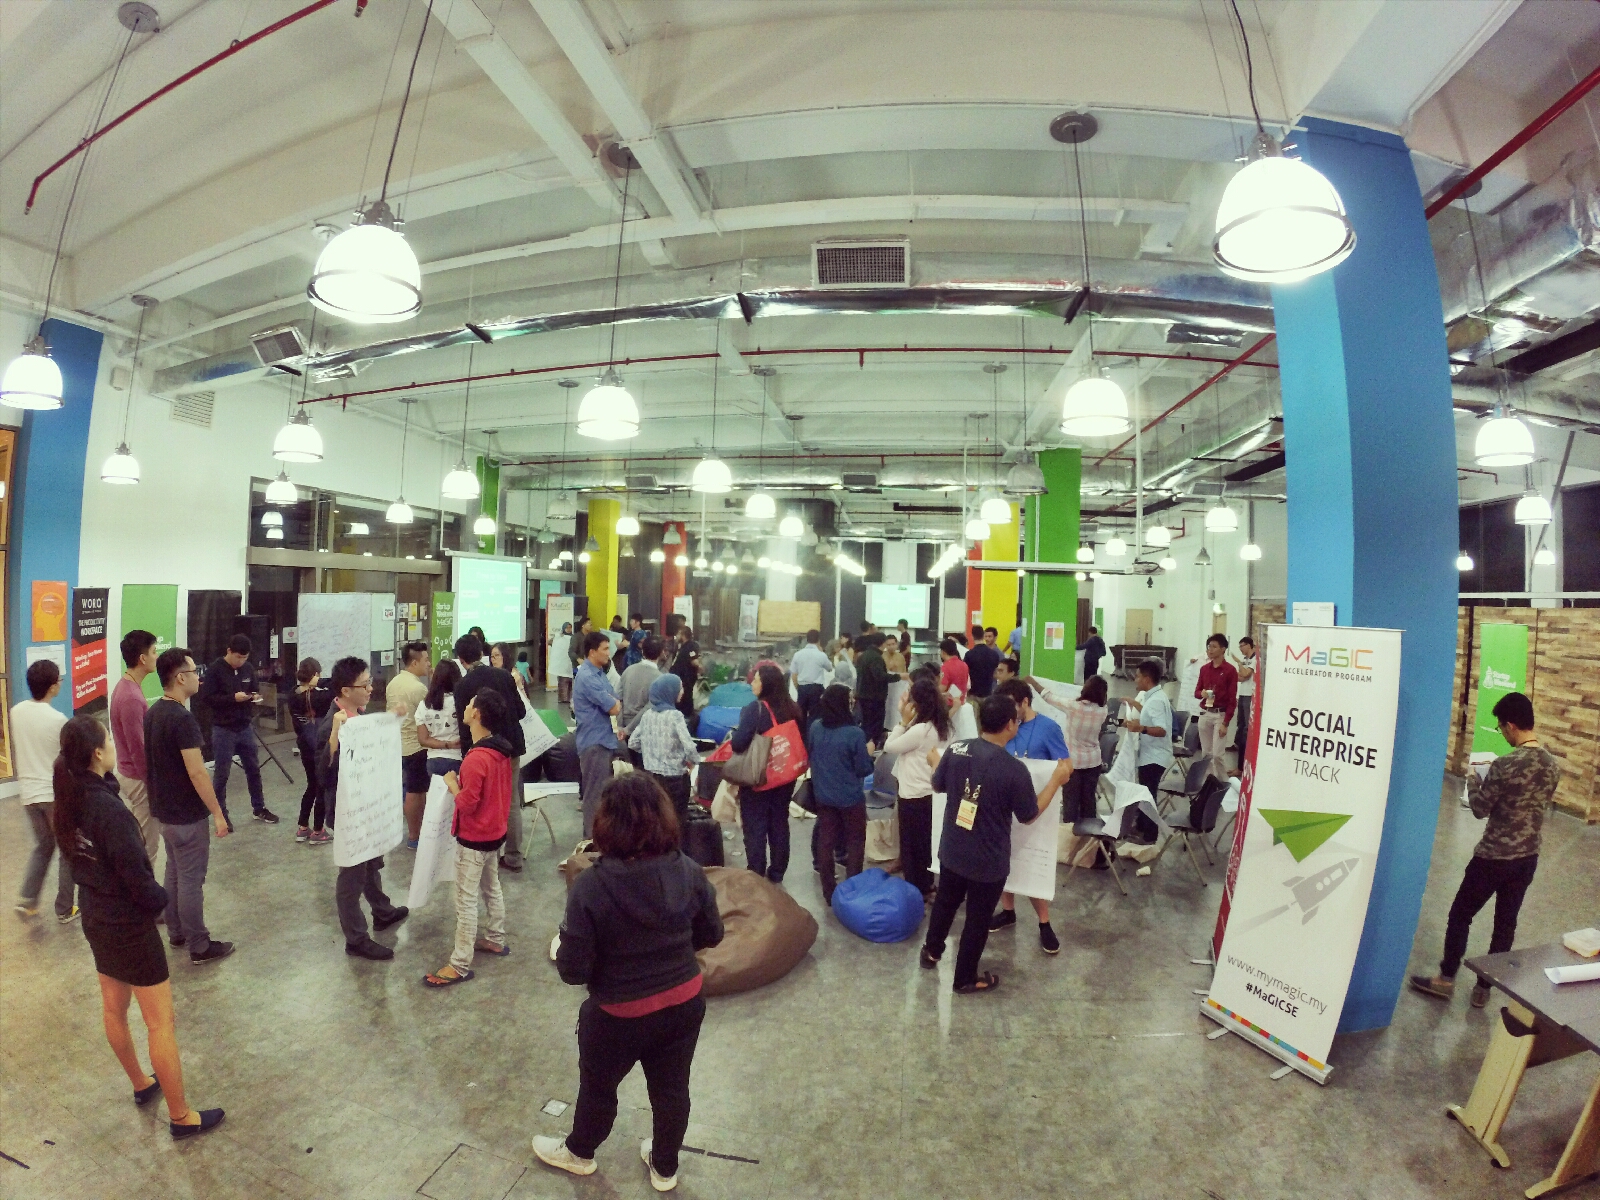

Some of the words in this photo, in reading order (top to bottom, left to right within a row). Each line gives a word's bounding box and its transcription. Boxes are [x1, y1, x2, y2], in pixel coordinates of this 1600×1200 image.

[1285, 645, 1374, 671] MaGIC
[1284, 667, 1333, 678] ACCELERATOR
[1335, 672, 1372, 683] PROGRAM
[1287, 707, 1356, 738] SOCIAL
[1265, 727, 1378, 769] ENTERPRISE
[1293, 758, 1341, 785] TRACK
[1227, 954, 1328, 1016] www.mymagic.my
[1245, 982, 1300, 1018] #MaGICSE
